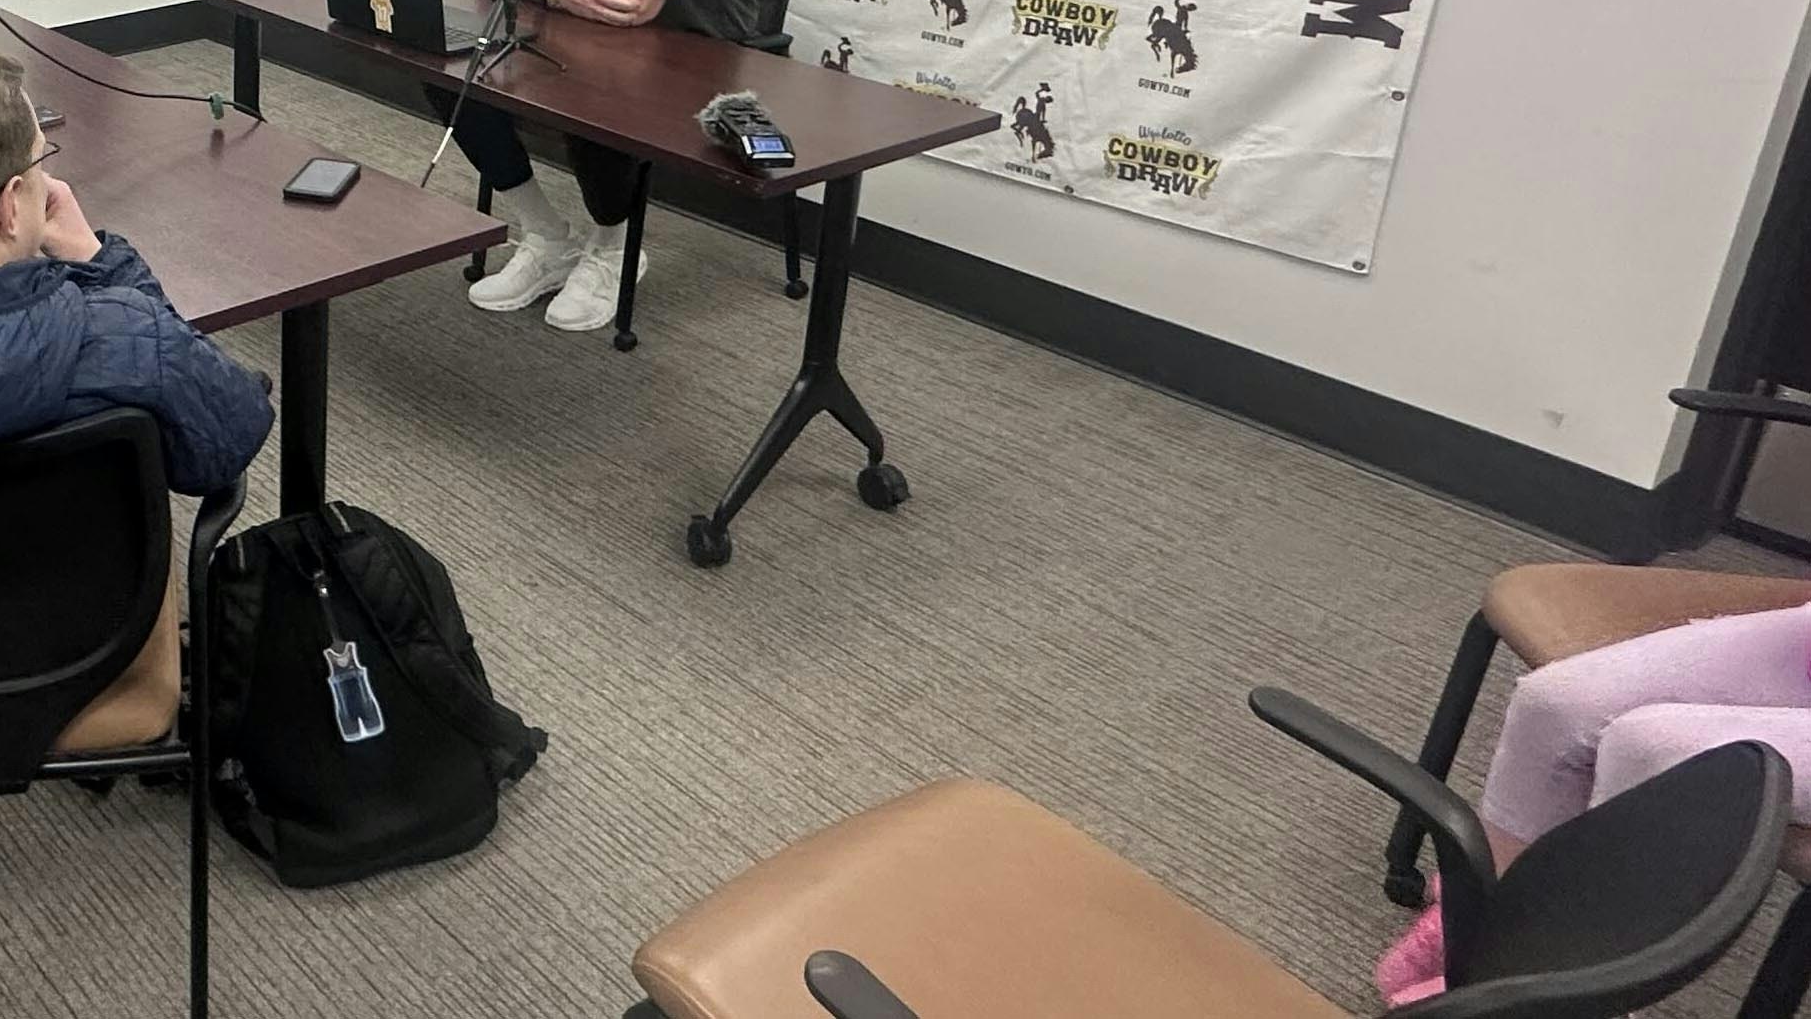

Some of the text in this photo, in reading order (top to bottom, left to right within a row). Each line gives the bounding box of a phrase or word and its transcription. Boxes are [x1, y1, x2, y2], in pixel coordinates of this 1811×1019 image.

[1022, 17, 1097, 46] DRAW
[1138, 78, 1190, 97] GOWYO.COM
[1005, 162, 1051, 181] GOWYO.COM
[1108, 138, 1217, 176] COWBOY
[1117, 164, 1197, 194] DRAW
